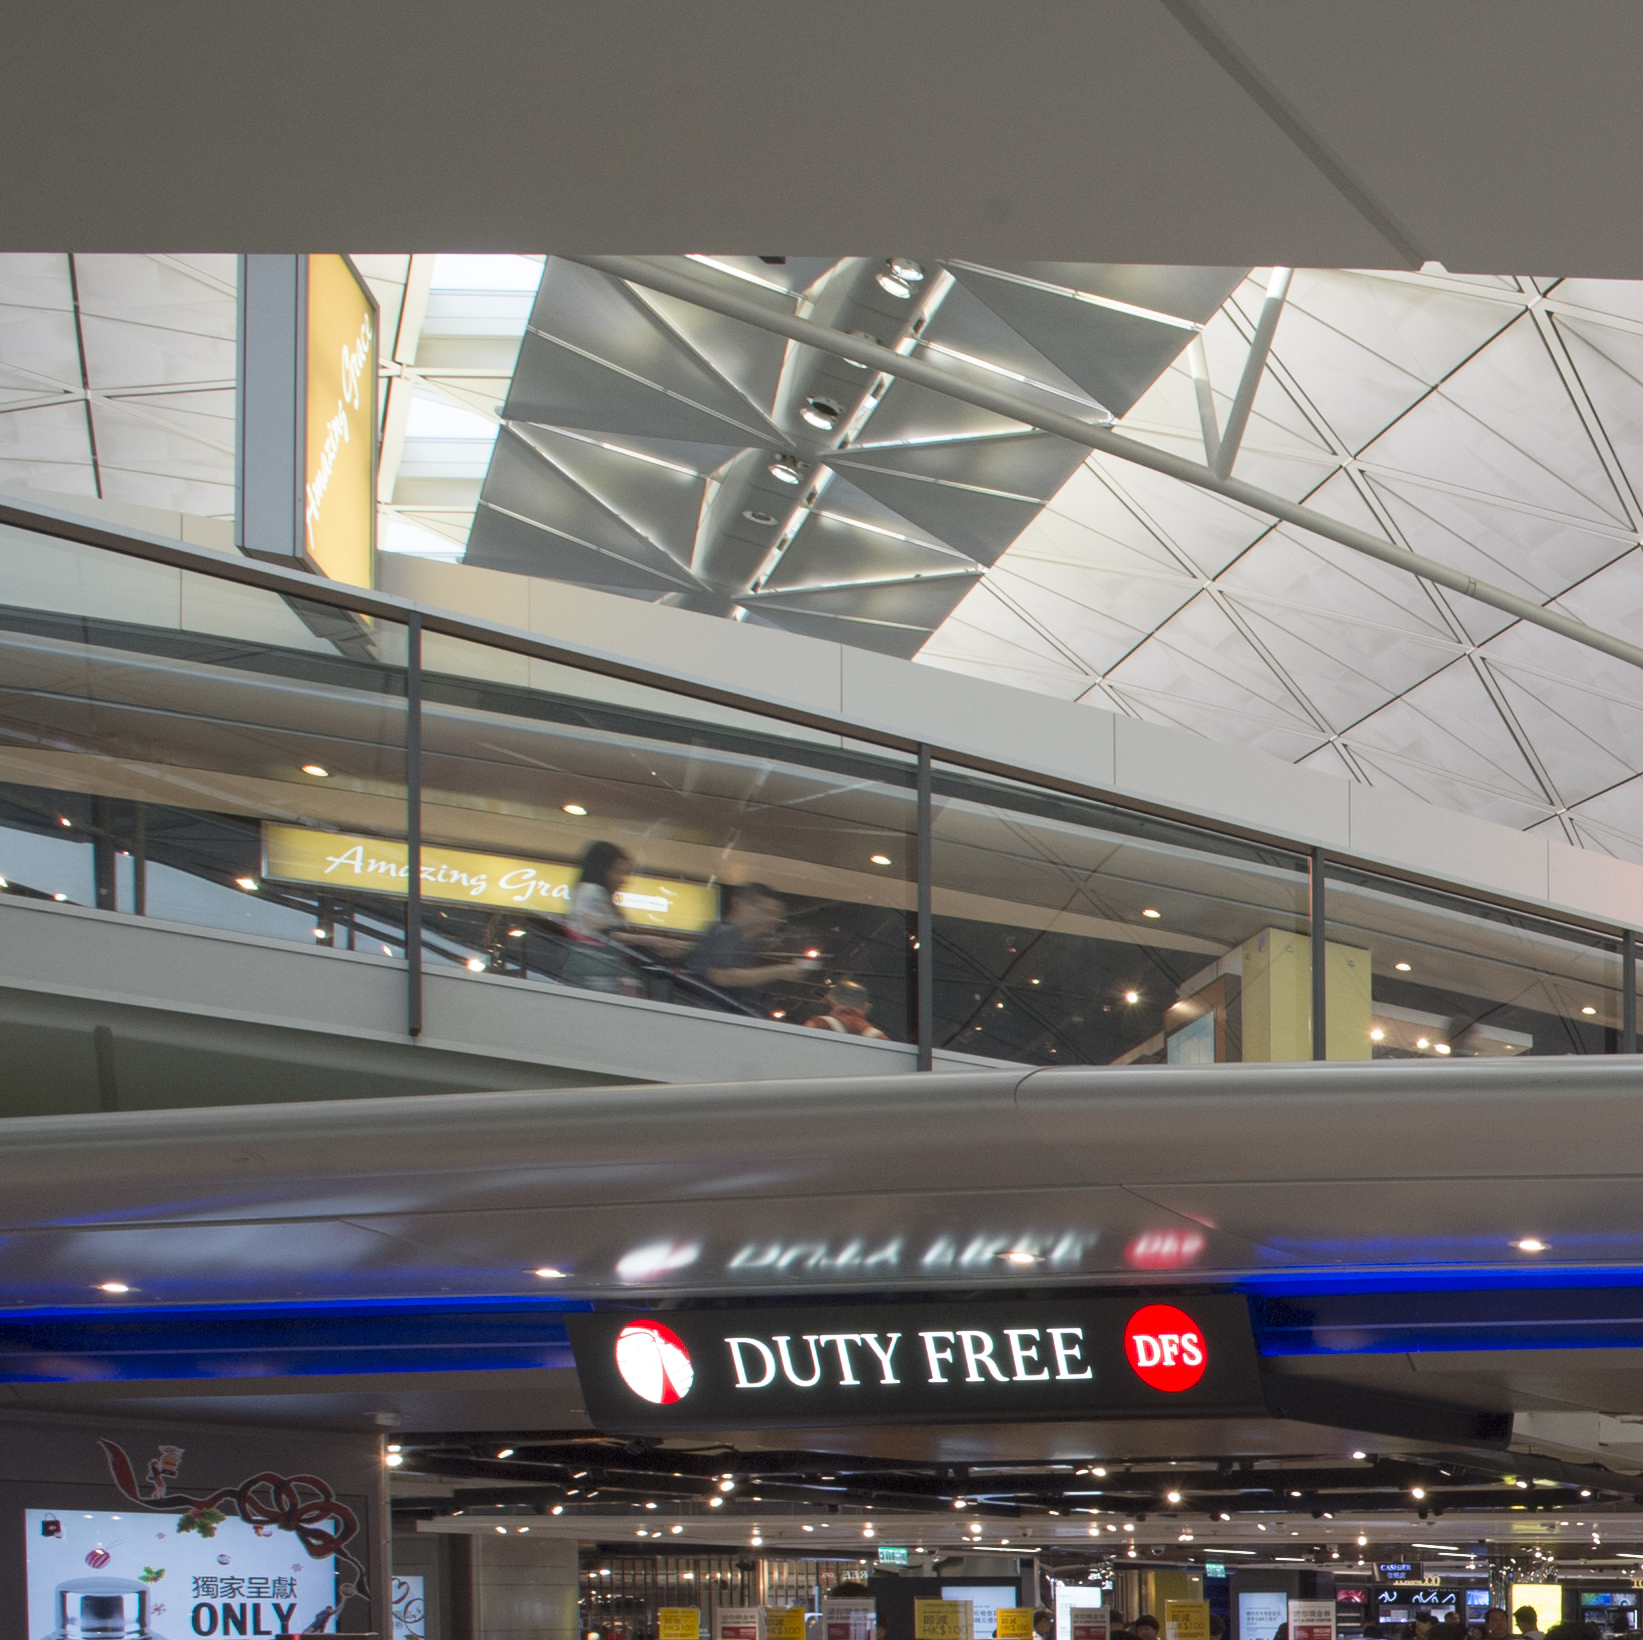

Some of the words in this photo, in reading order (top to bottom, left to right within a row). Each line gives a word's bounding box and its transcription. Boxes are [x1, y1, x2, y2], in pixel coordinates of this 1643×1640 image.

[306, 399, 349, 550] Amazing
[342, 313, 372, 410] Grace
[499, 868, 571, 901] Gra
[724, 1332, 902, 1389] DUTY
[917, 1327, 1094, 1383] FREE
[1132, 1333, 1203, 1369] DFS
[191, 1575, 298, 1600] 獨家呈獻
[191, 1602, 298, 1637] ONLY
[923, 1625, 967, 1637] HK$100
